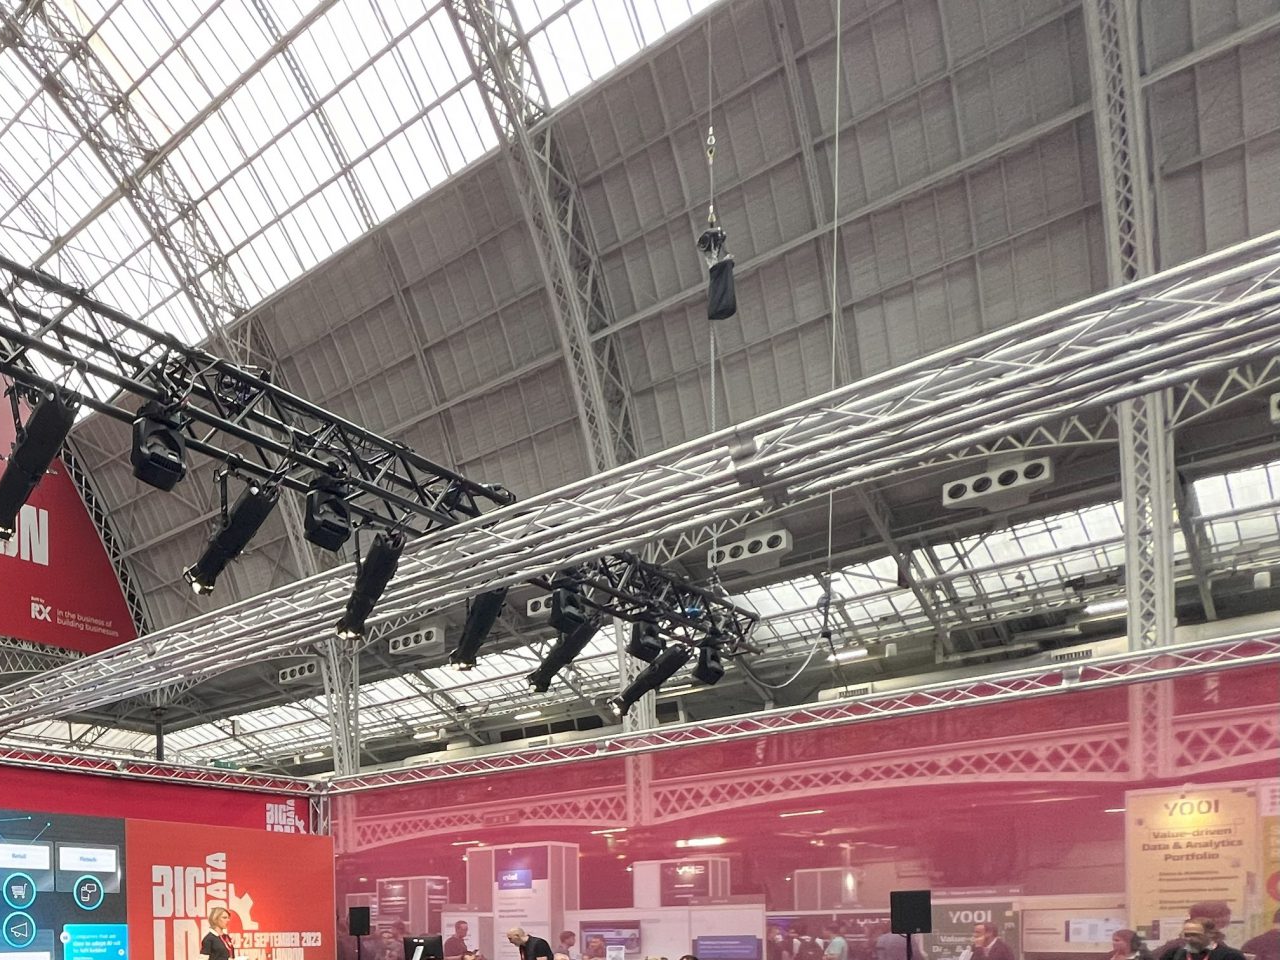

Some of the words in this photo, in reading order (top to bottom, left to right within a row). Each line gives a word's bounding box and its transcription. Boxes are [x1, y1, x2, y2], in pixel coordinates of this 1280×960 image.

[30, 602, 52, 622] RX
[64, 610, 77, 619] the
[77, 614, 105, 626] business
[56, 617, 84, 631] building
[266, 803, 287, 825] BIG
[1142, 842, 1170, 852] Data
[1172, 841, 1183, 851] &
[1185, 838, 1244, 851] Analytics
[1163, 851, 1220, 862] Portfolio
[151, 865, 206, 918] BIG
[948, 909, 992, 924] YOOI
[253, 931, 300, 948] SEPTEMBER
